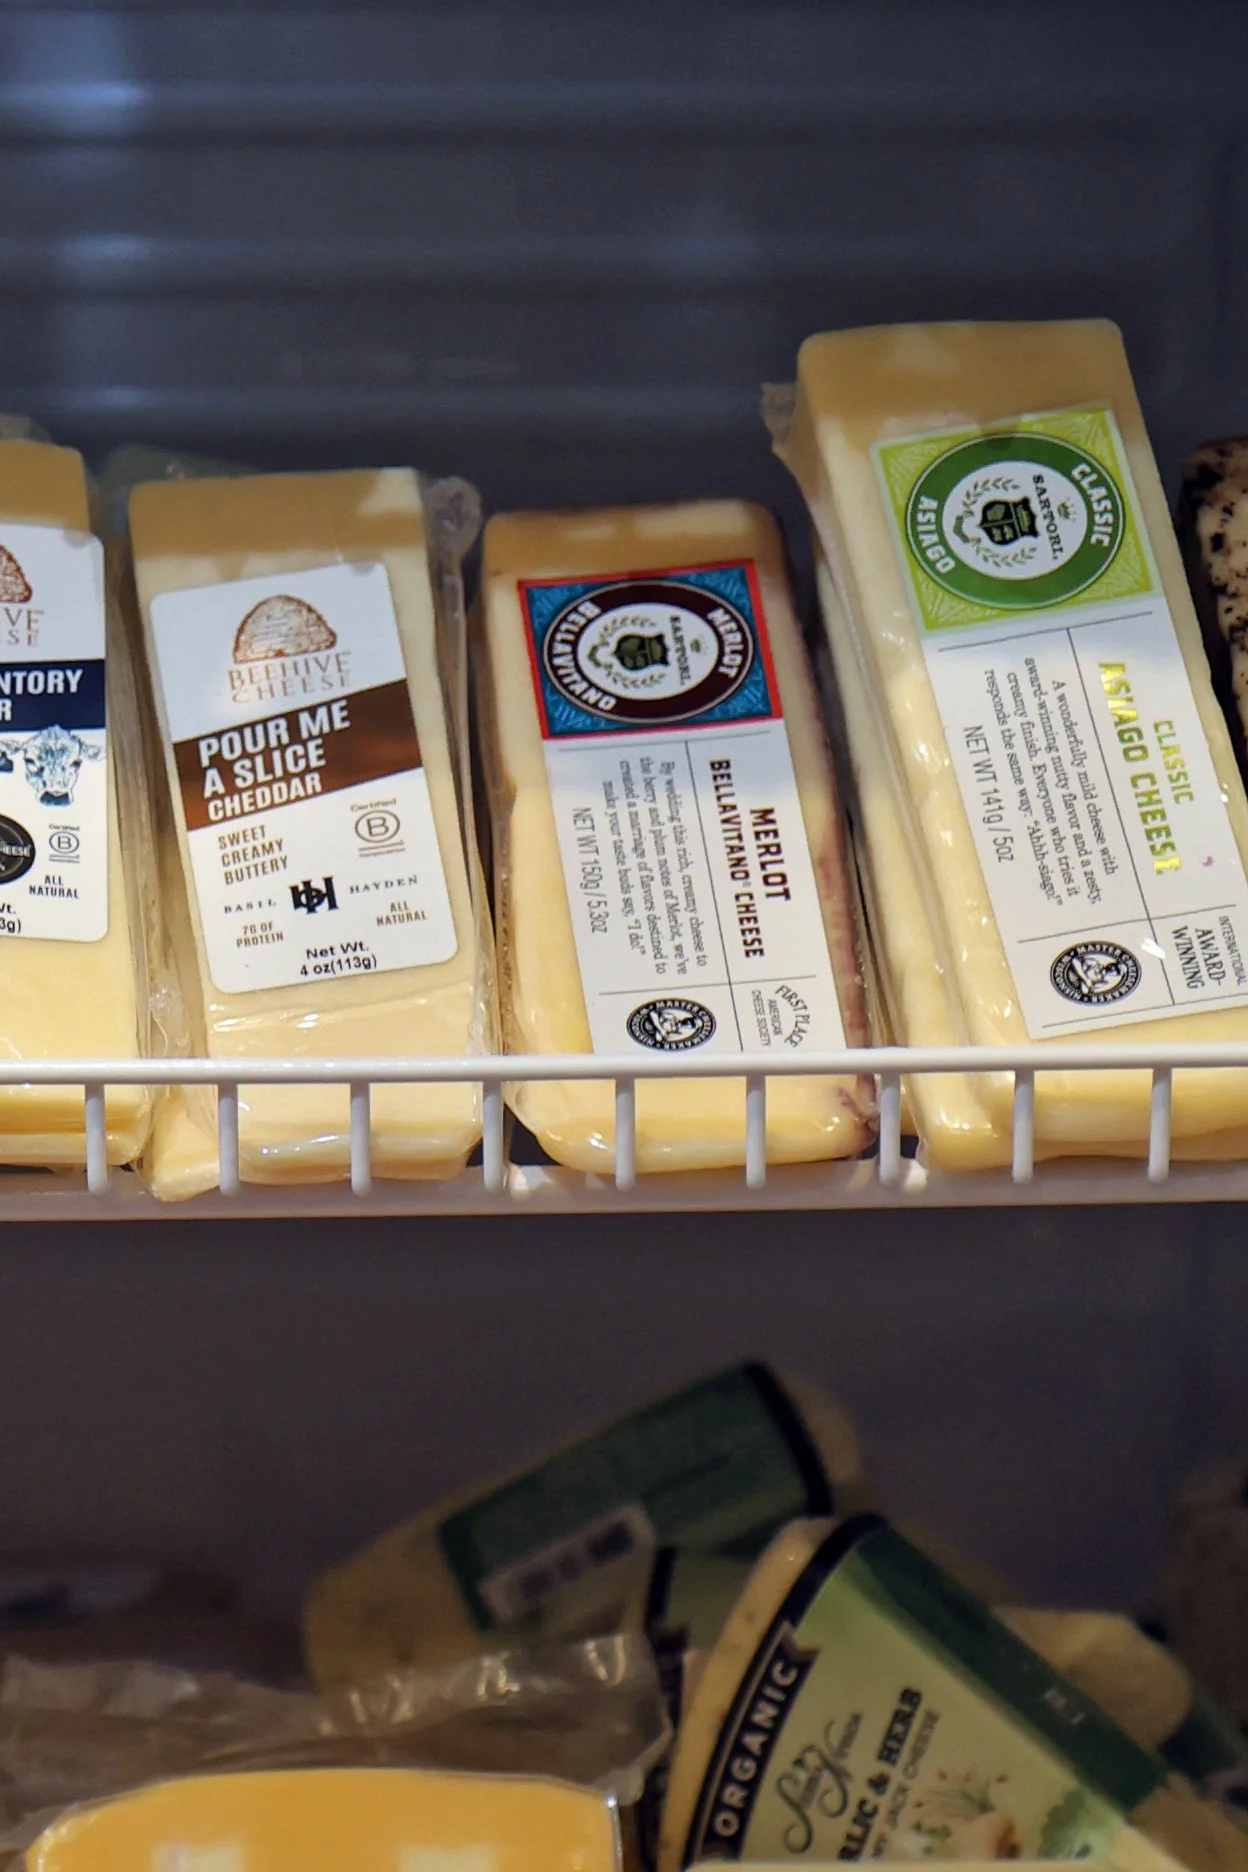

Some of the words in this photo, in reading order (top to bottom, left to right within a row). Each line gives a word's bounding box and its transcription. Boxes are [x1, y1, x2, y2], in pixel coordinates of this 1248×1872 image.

[1071, 463, 1114, 547] CLASSIC
[916, 495, 956, 574] ASIAGO
[552, 600, 617, 711] BELLAVITANO
[706, 607, 744, 679] MERLOT
[227, 651, 352, 692] BEEHIVE
[232, 678, 352, 705] CHEESE
[199, 720, 288, 768] POUR
[299, 699, 352, 737] ME
[963, 724, 991, 755] NET
[203, 766, 225, 799] A
[233, 739, 327, 788] SLICE
[972, 758, 998, 783] WT
[1098, 661, 1150, 763] ASIAGO
[1129, 771, 1182, 876] CHEESE
[1153, 719, 1195, 805] CLASSIC
[207, 771, 322, 822] CHEDDAR
[981, 788, 1003, 825] 141g
[572, 807, 595, 832] NET
[218, 825, 267, 850] SWEET
[221, 839, 285, 867] CREAMY
[577, 836, 600, 857] WT
[749, 807, 791, 901] MERLOT
[992, 835, 1015, 863] 5oz
[224, 855, 289, 885] BUTTERY
[580, 860, 602, 890] 150g
[224, 899, 277, 914] BASIL
[349, 874, 419, 894] HAYDEN
[390, 900, 410, 914] ALL
[260, 922, 274, 934] OF
[376, 910, 428, 928] NATURAL
[587, 900, 609, 933] 5.3oz
[734, 892, 765, 959] CHEESE
[236, 931, 284, 948] PROTEIN
[305, 945, 336, 960] Net
[340, 941, 370, 956] Wt.
[1171, 924, 1205, 990] WINNING
[1194, 927, 1227, 987] AWARD-
[1218, 916, 1248, 986] INTERNATIONAL
[299, 963, 310, 978] 4
[313, 953, 378, 976] oz(113g)
[774, 984, 808, 1011] FIRST
[784, 1014, 810, 1047] PLACE
[877, 1687, 922, 1766] HERB
[713, 1653, 802, 1839] ORGANIC
